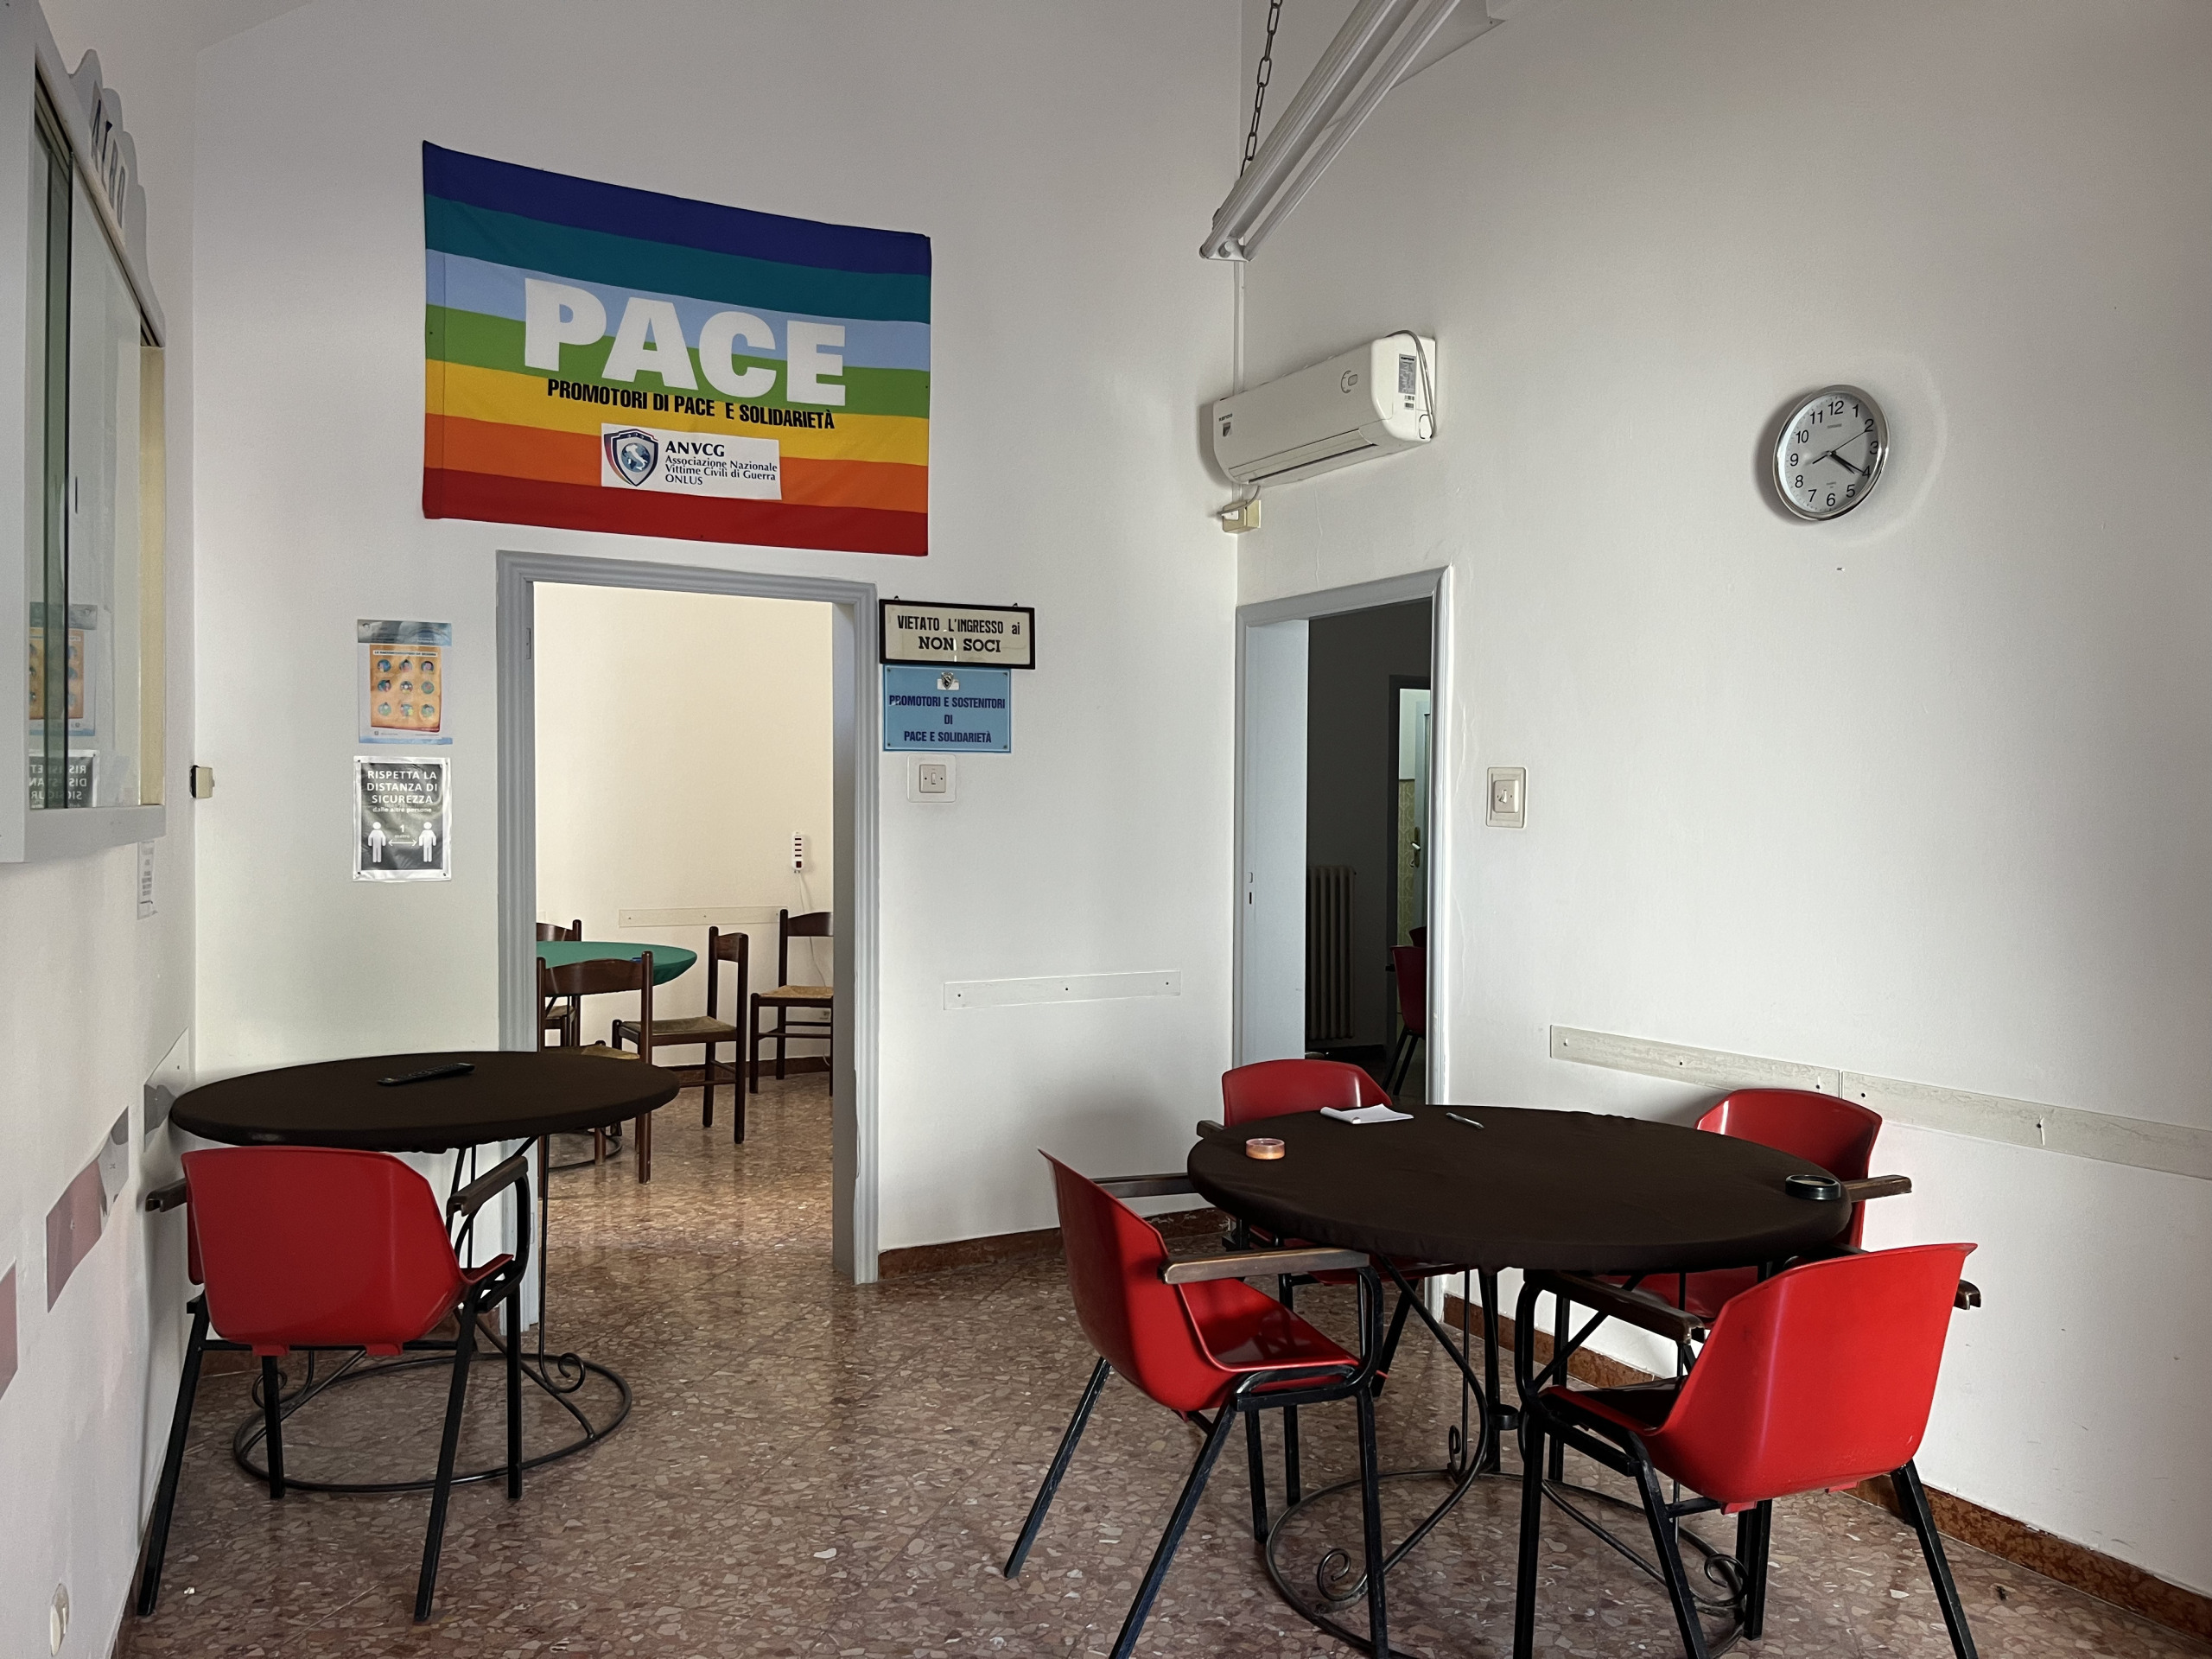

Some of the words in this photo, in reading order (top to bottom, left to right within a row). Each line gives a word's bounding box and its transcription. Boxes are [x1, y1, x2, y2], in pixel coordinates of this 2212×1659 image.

[524, 277, 846, 406] PACE
[547, 378, 648, 410] PROMOTORI
[652, 392, 670, 411] DI
[674, 395, 715, 416] PACE
[725, 402, 734, 420] E
[739, 404, 835, 429] SOLIDARIETÀ
[1827, 400, 1844, 416] 12
[1853, 404, 1859, 417] 1
[1809, 410, 1824, 424] 11
[1864, 418, 1874, 432] 2
[1796, 429, 1809, 443] 10
[664, 440, 725, 457] ANVCG
[1869, 441, 1879, 454] 3
[664, 455, 728, 468] Associazione
[729, 461, 778, 473] Nazionale
[1789, 453, 1799, 467] 9
[664, 464, 702, 475] Vittime
[703, 467, 728, 478] Civili
[730, 468, 741, 478] di
[743, 471, 776, 481] Guerra
[1863, 466, 1871, 478] 4
[664, 474, 703, 486] ONLUS
[1795, 475, 1804, 488] 8
[1808, 489, 1817, 502] 7
[1846, 484, 1856, 498] 5
[1826, 493, 1836, 506] 6
[897, 614, 940, 631] VIETATO
[948, 618, 1004, 634] L'INGRESSO
[1011, 621, 1020, 635] ai
[918, 635, 956, 651] NON
[963, 638, 1001, 653] SOCI
[888, 695, 941, 708] PROMOTORI
[944, 696, 949, 708] E
[951, 696, 1006, 709] SOSTENITORI
[944, 714, 953, 725] DI
[904, 730, 927, 742] PACE
[930, 731, 935, 742] E
[938, 730, 992, 743] SOLIDARIETÀ
[367, 770, 420, 779] RISPETTA
[423, 771, 437, 779] LA
[366, 782, 423, 791] DISTANZA
[426, 783, 438, 792] DI
[372, 794, 433, 804] SICUREZZA
[399, 823, 405, 833] 1
